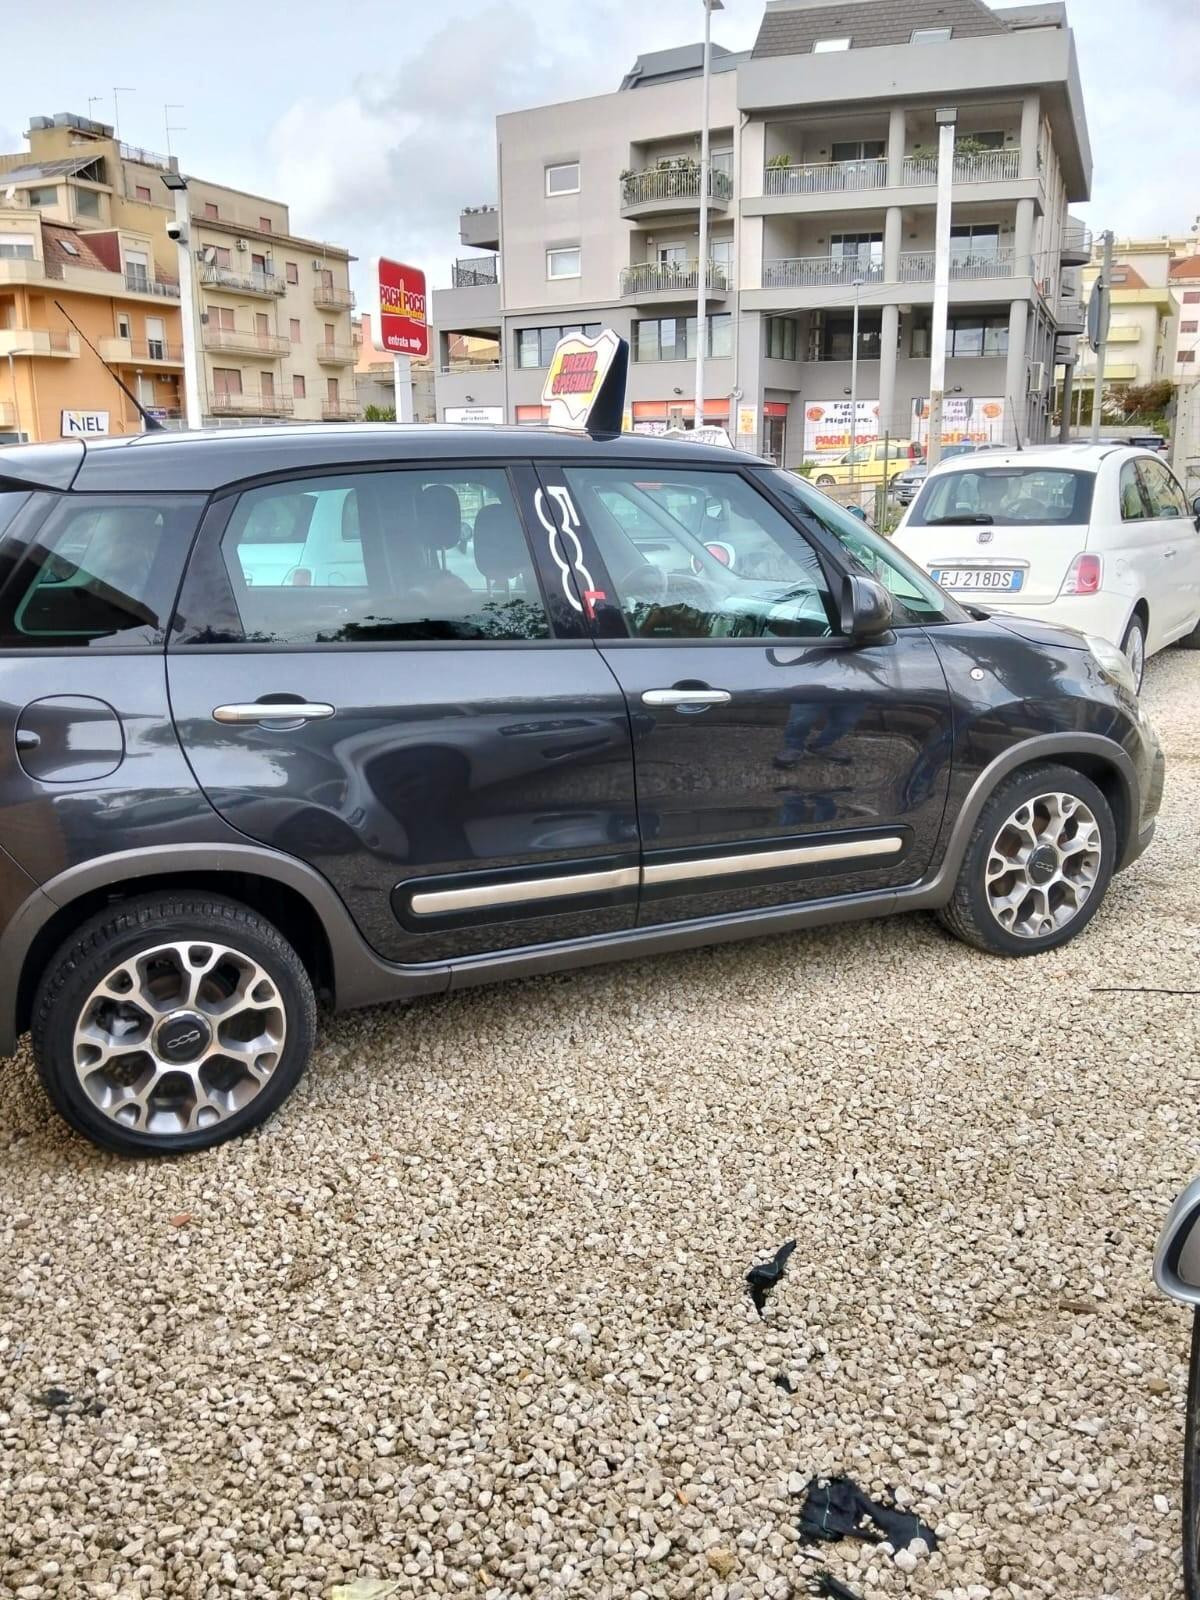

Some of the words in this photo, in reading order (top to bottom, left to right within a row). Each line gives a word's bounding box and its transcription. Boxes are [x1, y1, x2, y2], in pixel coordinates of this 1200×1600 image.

[388, 335, 409, 347] entrata
[560, 351, 598, 374] PREZZO
[552, 371, 598, 395] SPECIALE
